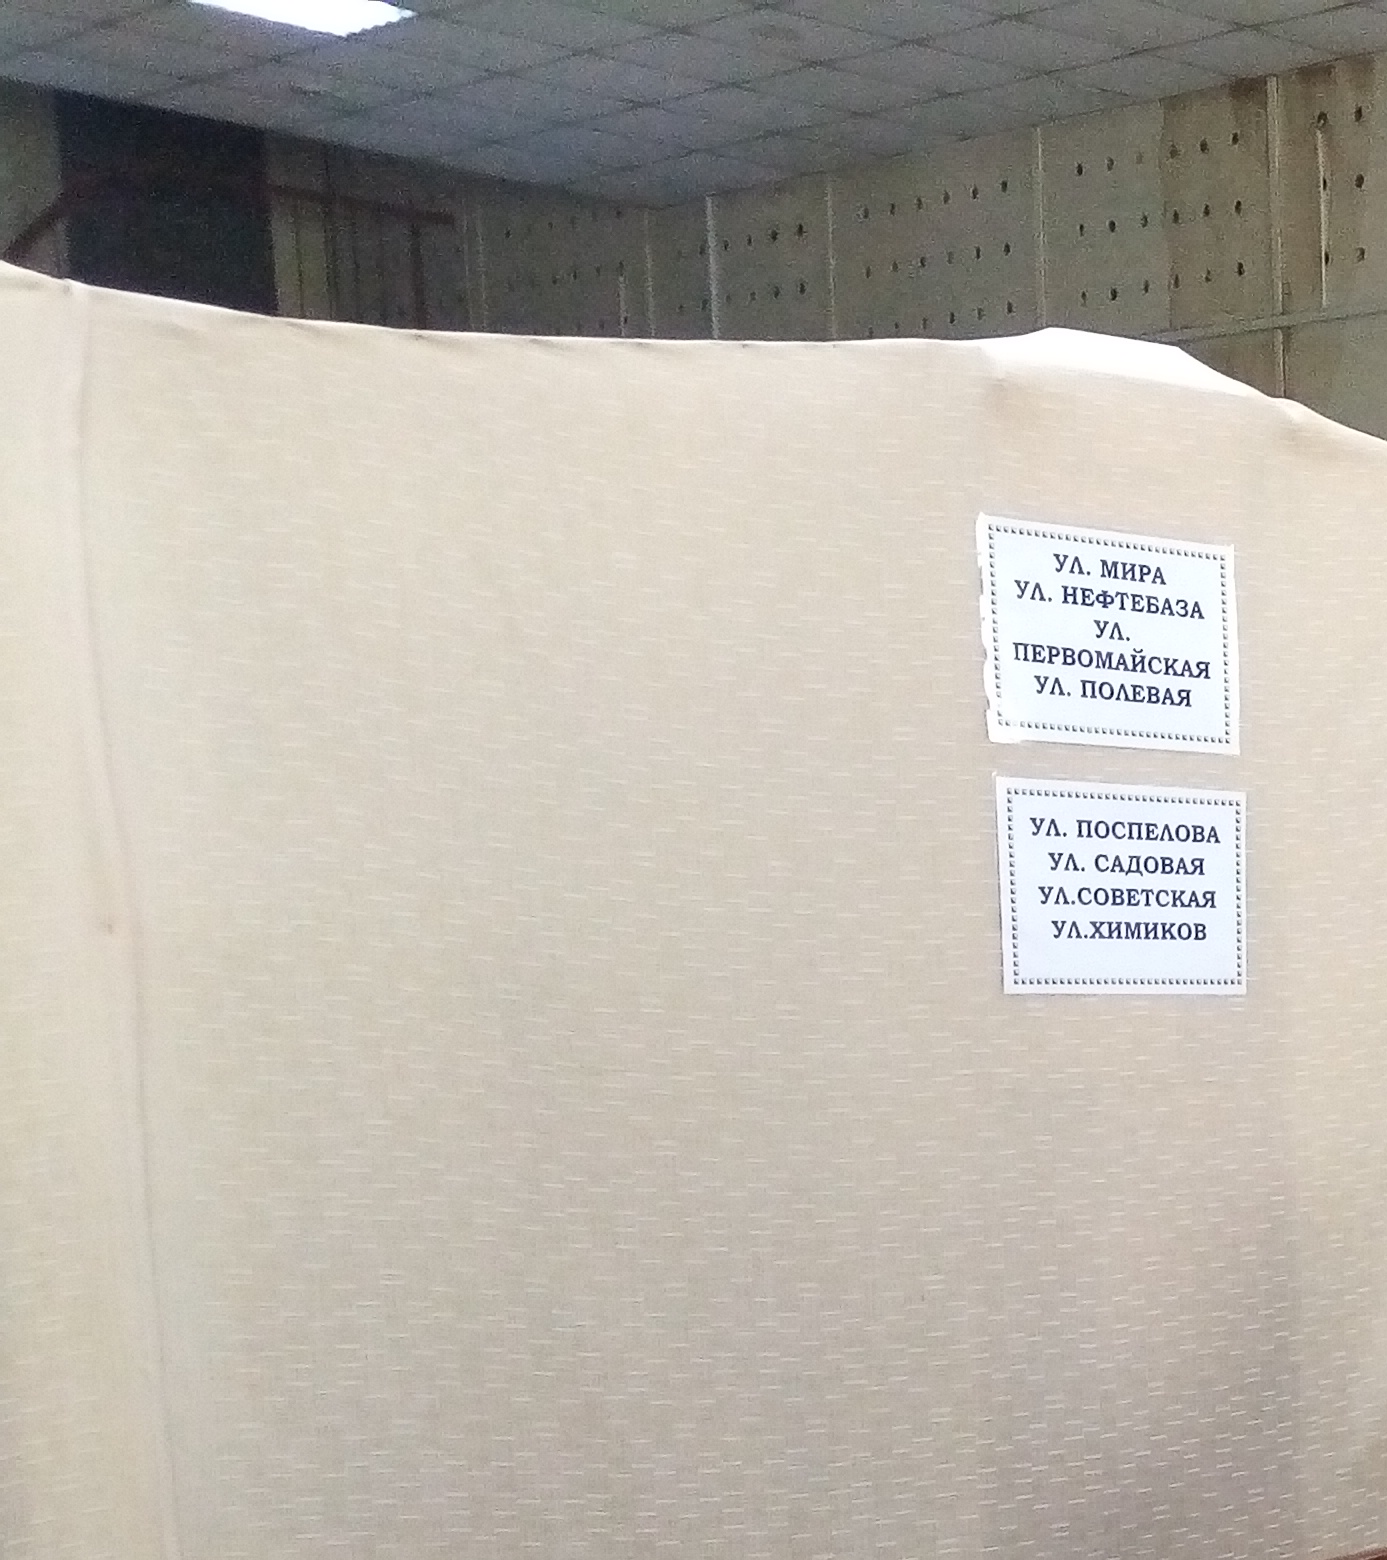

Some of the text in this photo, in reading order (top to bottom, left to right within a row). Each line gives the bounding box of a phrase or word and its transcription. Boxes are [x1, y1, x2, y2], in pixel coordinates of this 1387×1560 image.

[1053, 553, 1167, 586] УЛ. МИРА
[1013, 580, 1206, 620] УЛ. НЕФТЕБАЗА
[1093, 619, 1131, 642] УЛ.
[1012, 641, 1211, 680] ПЕРВОМАЙСКАЯ
[1033, 675, 1193, 708] УЛ. ПОЛЕВАЯ
[1029, 817, 1221, 844] УЛ. ПОСПЕЛОВА
[1047, 852, 1206, 877] УЛ. САДОВАЯ
[1037, 885, 1217, 909] УЛ.СОВЕТСКАЯ
[1050, 920, 1207, 941] УЛ.ХИМИКОВ
